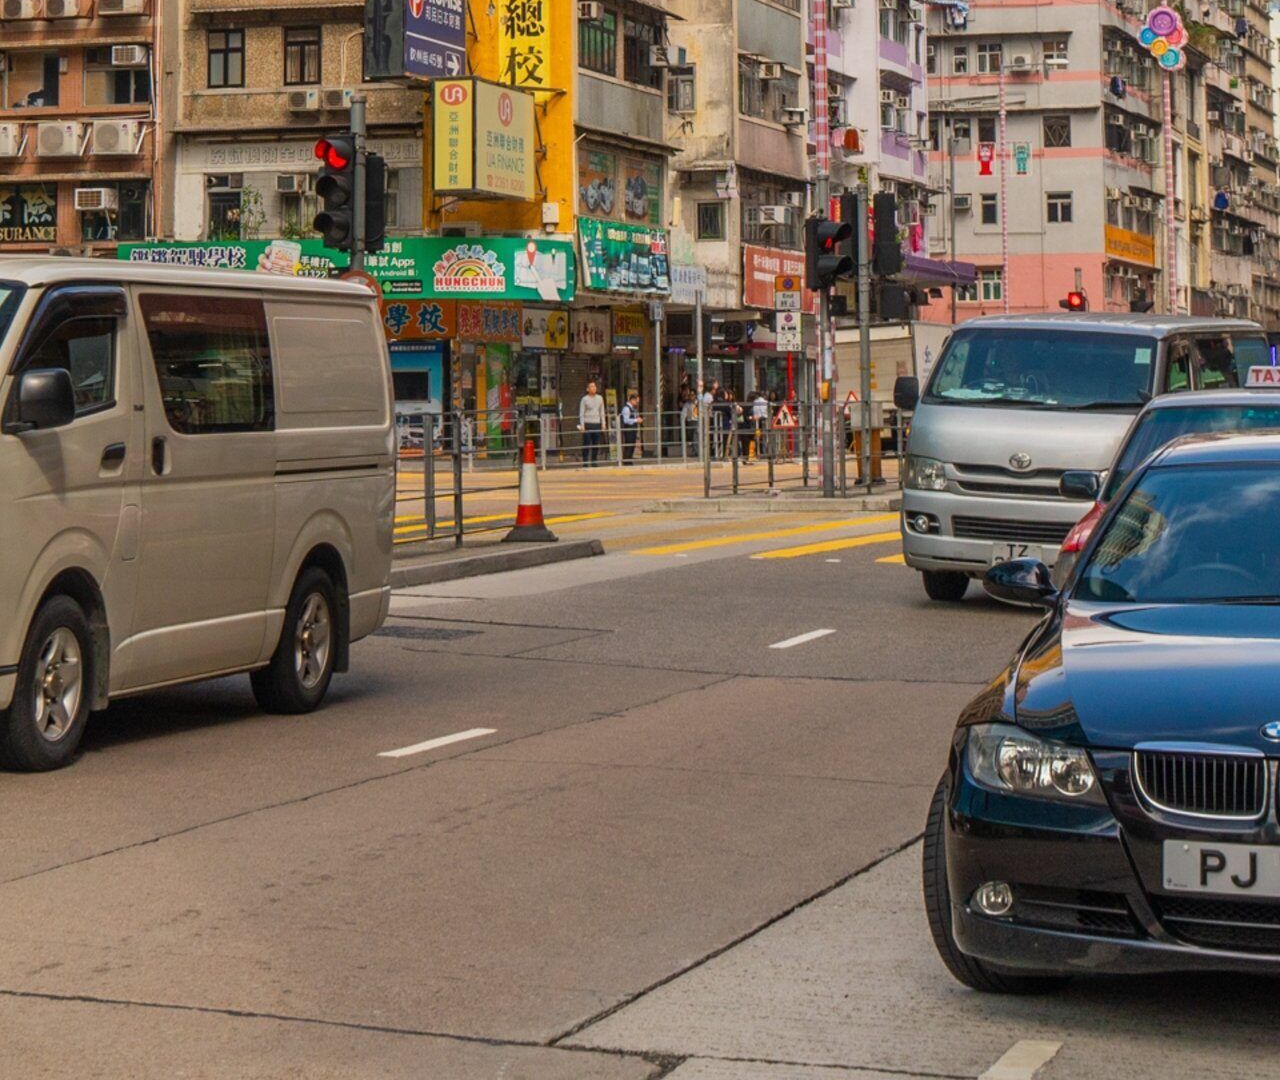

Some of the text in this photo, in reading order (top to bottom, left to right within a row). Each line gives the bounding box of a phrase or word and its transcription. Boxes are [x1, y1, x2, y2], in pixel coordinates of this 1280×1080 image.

[391, 257, 415, 268] Apps
[435, 277, 504, 287] HUNGCHUN
[384, 303, 447, 335] 學校
[1007, 543, 1029, 557] TZ
[1199, 848, 1258, 889] PJ
